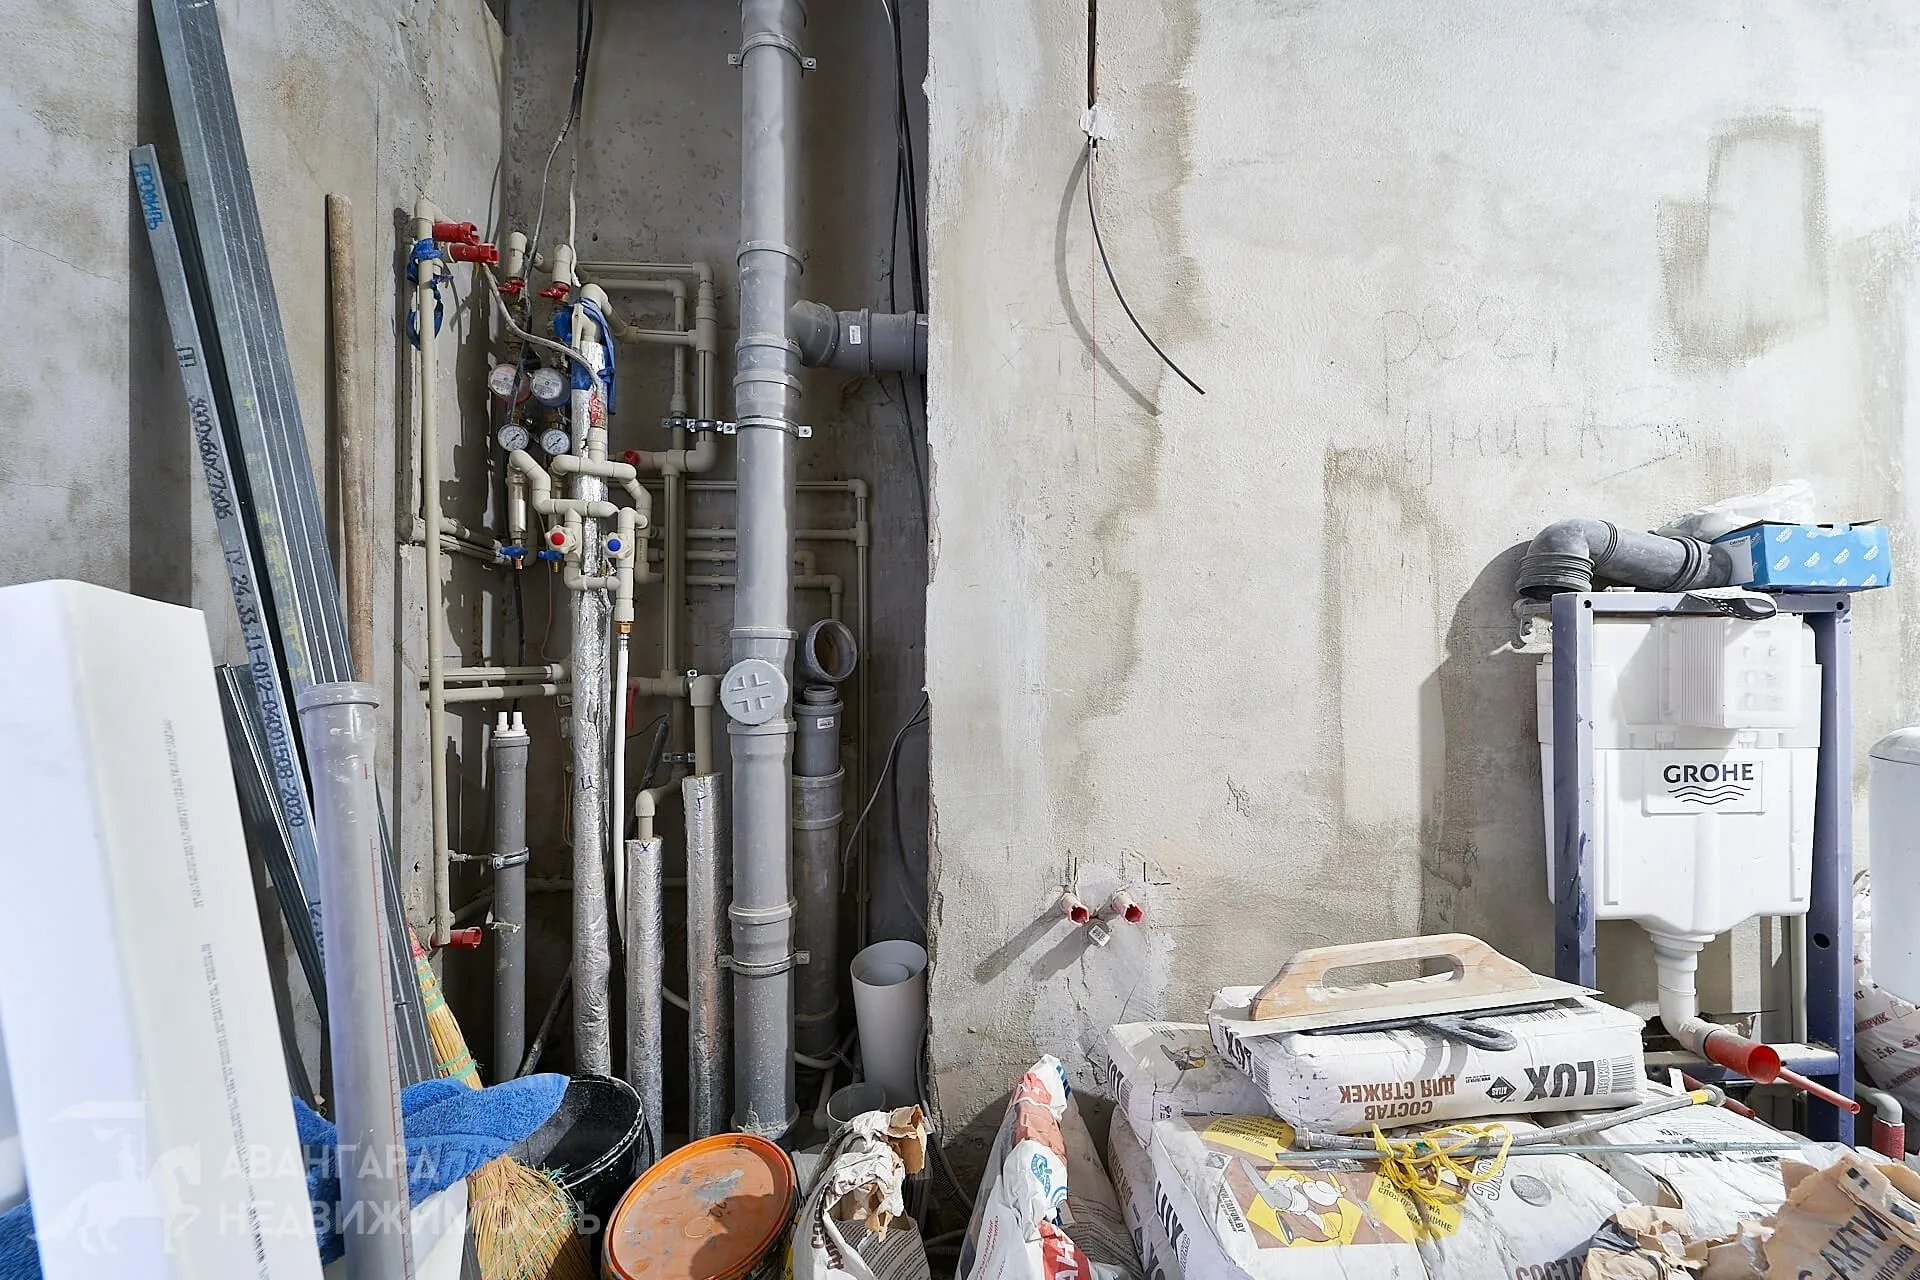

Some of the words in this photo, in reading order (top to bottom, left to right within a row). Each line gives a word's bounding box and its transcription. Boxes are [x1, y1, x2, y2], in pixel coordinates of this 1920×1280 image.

[133, 161, 165, 231] ПРОФИЛЬ
[1663, 763, 1754, 784] GROHE
[1337, 1080, 1416, 1105] СТЯЖЕК
[1420, 1075, 1456, 1098] ДЛЯ
[1523, 1060, 1596, 1102] LUX
[1364, 1101, 1433, 1121] СОСТАВ
